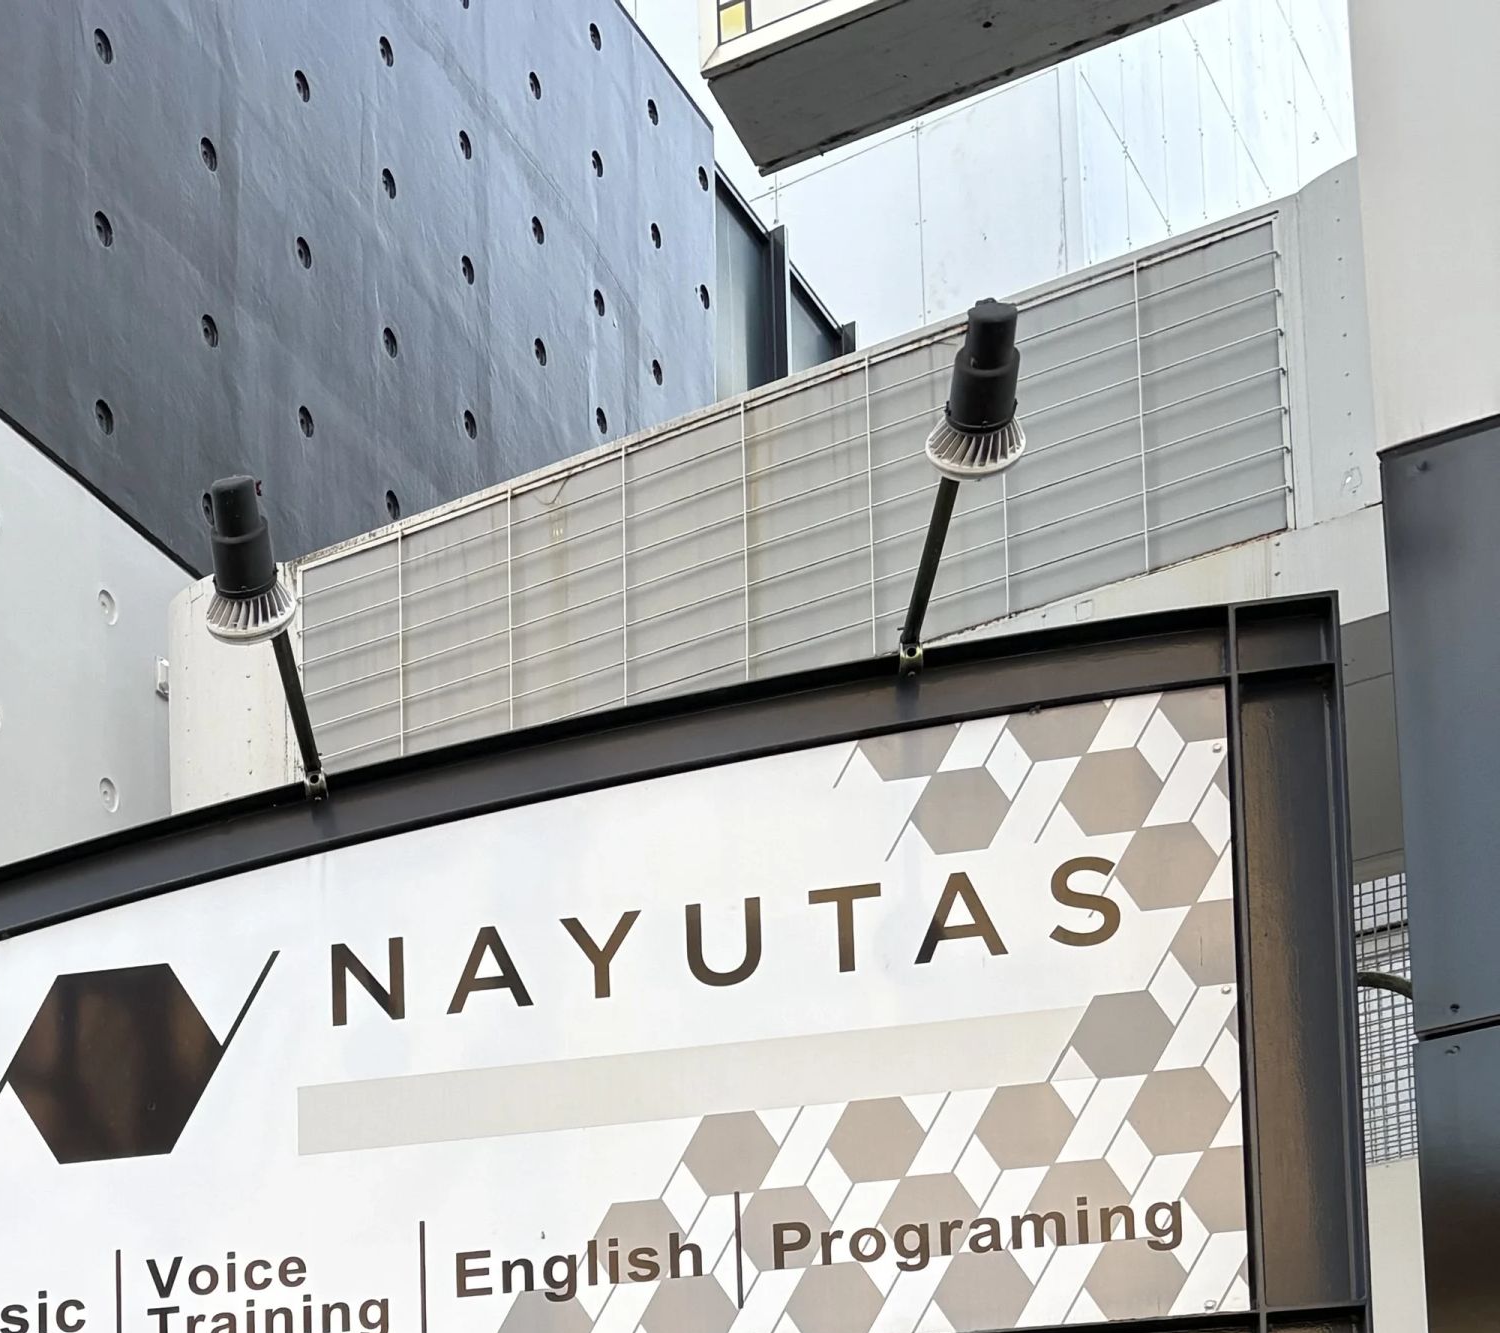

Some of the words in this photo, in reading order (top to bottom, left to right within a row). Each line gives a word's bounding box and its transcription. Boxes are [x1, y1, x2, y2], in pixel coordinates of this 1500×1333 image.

[331, 856, 1122, 1027] NAYUTAS
[455, 1233, 703, 1302] English
[772, 1197, 1184, 1272] Programing
[146, 1251, 312, 1300] Voice
